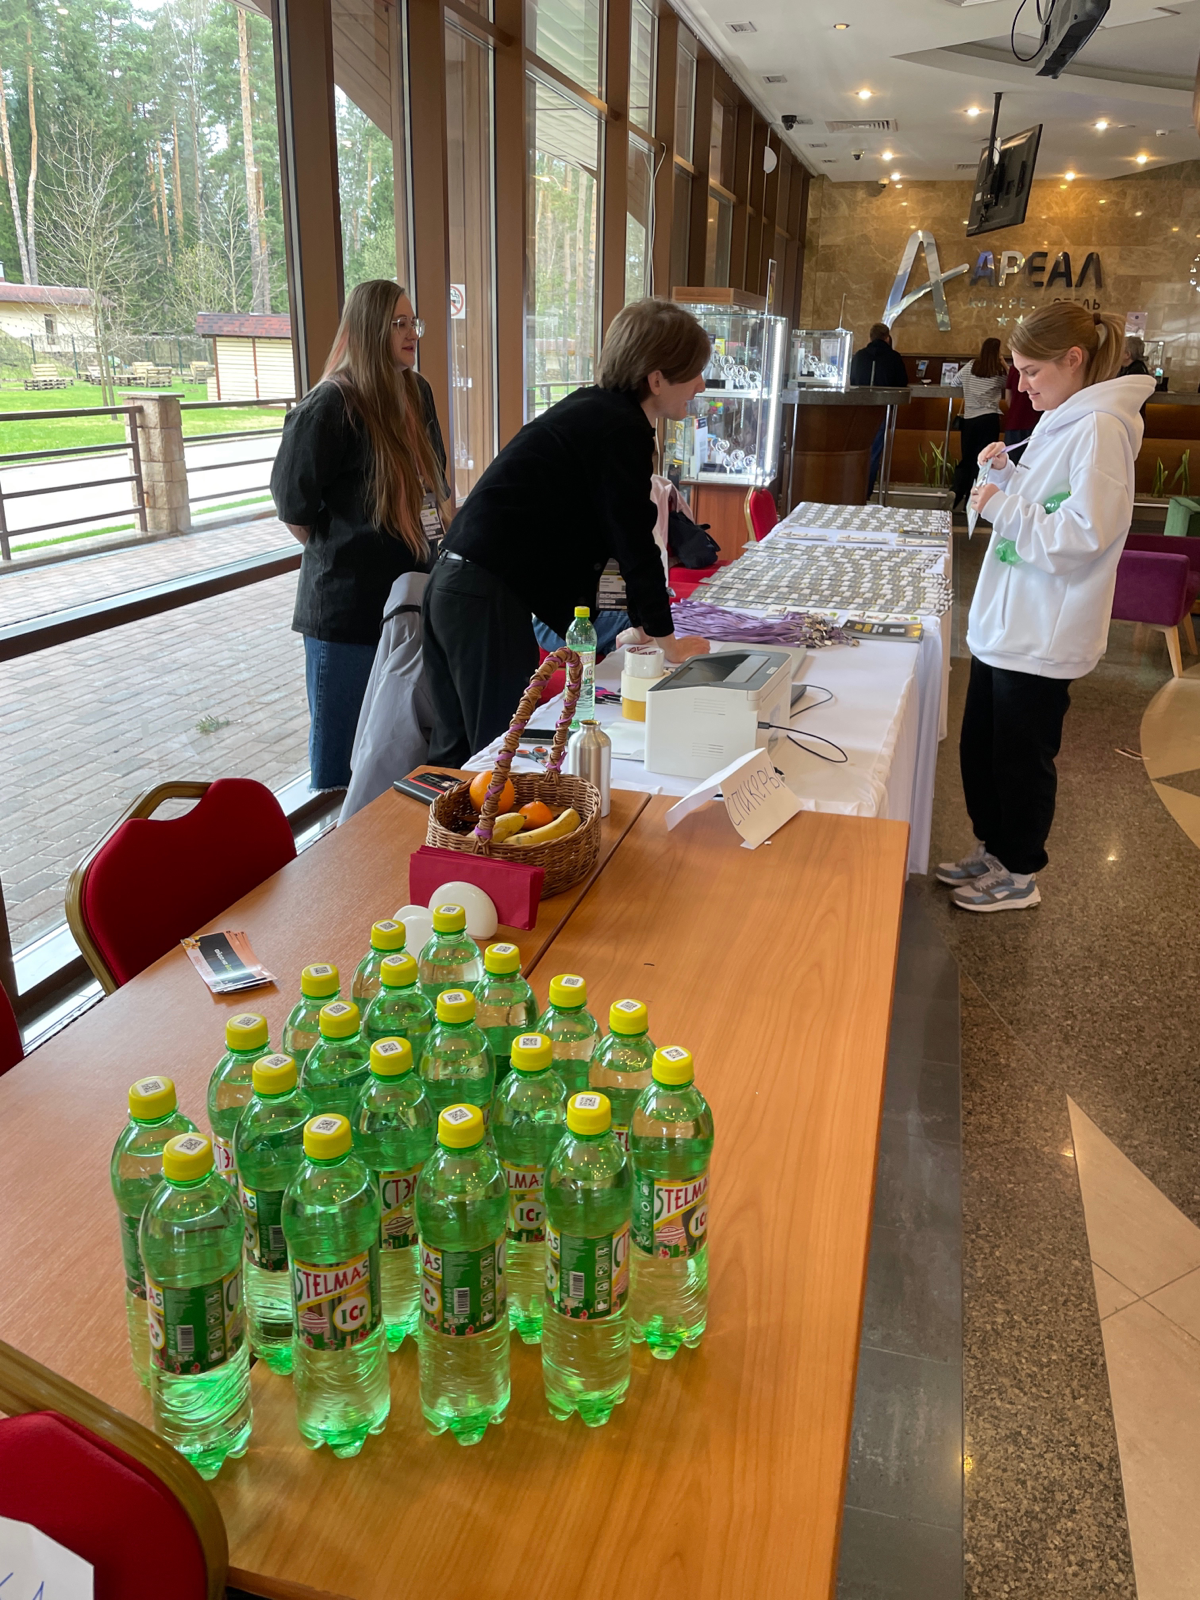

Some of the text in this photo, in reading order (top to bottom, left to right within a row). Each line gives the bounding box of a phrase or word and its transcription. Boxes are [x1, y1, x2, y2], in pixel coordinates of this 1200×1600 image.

[969, 250, 1103, 288] АРЕАЛ
[295, 1257, 369, 1303] STELMAS
[340, 1304, 366, 1325] ICr
